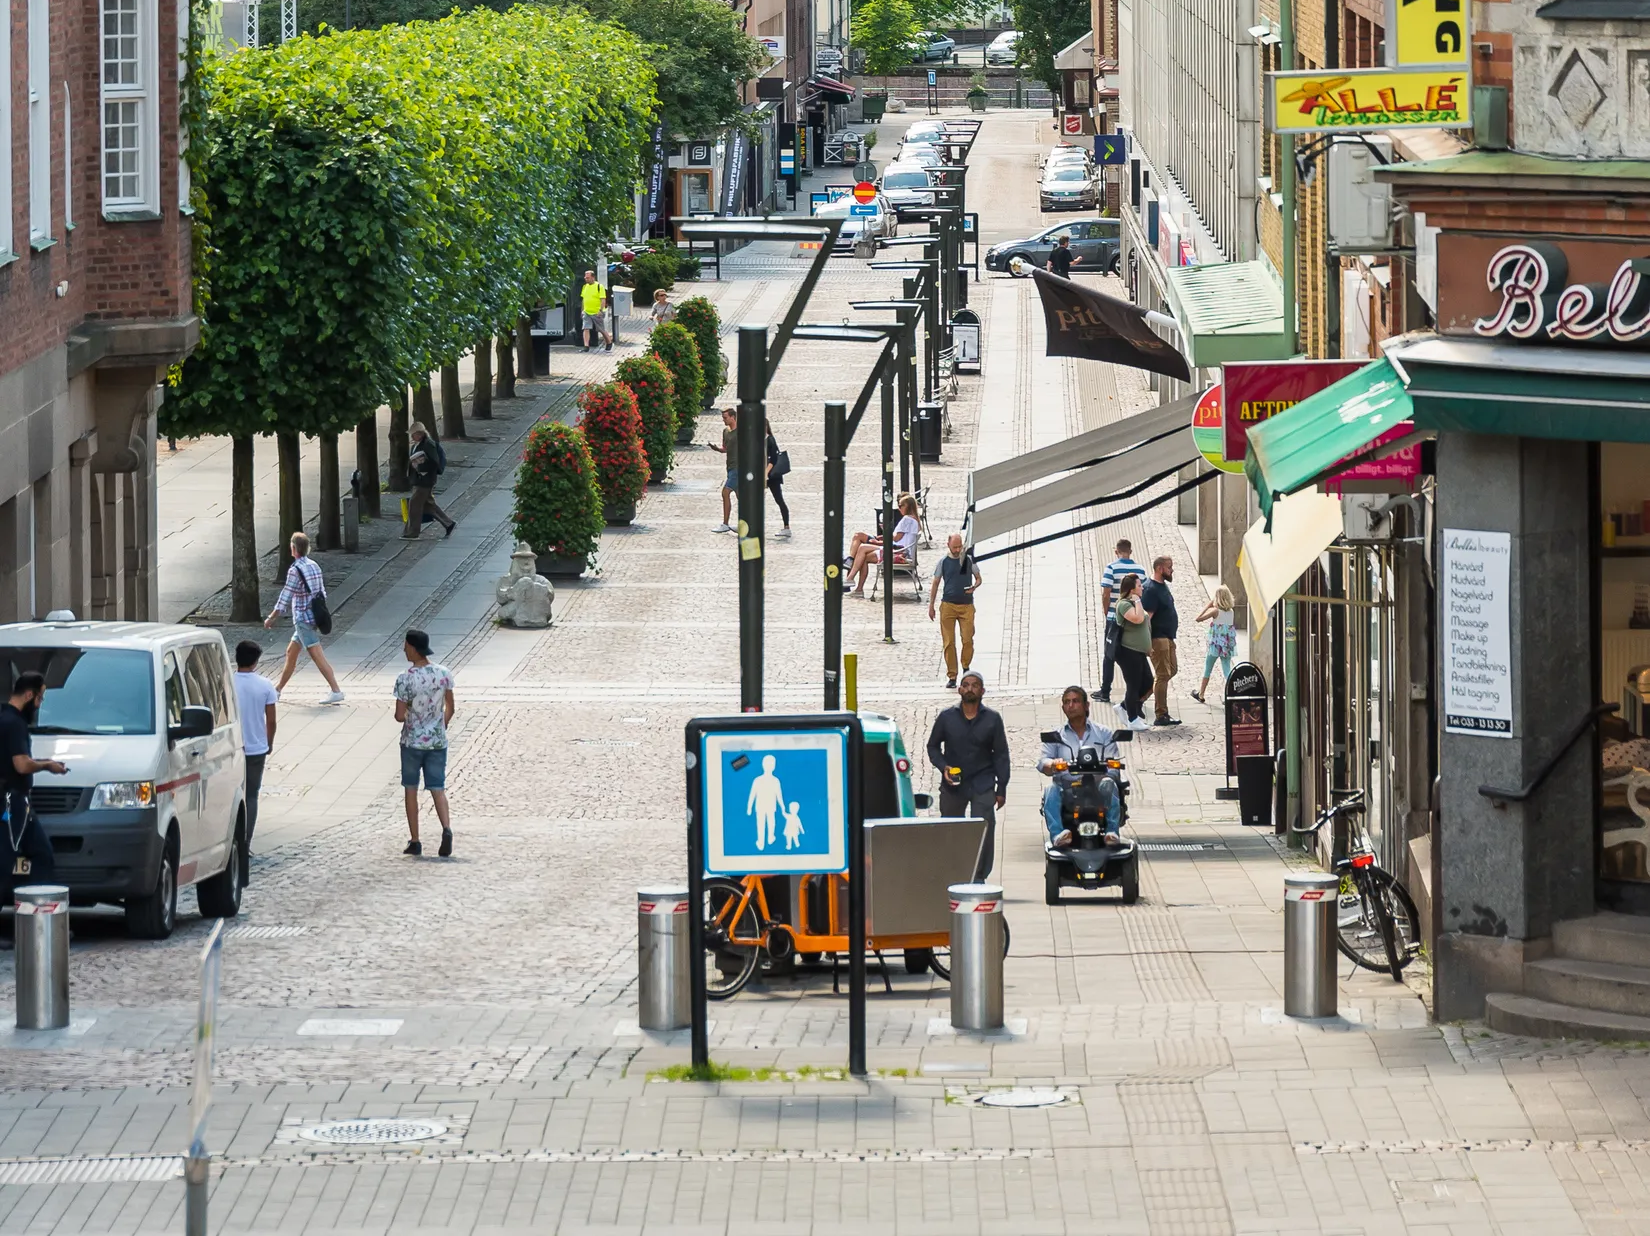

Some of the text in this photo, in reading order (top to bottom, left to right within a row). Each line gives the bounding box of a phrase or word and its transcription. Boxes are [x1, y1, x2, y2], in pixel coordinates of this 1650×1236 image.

[1299, 78, 1464, 114] ALLÉ
[728, 126, 742, 207] FRILUFTSFABRIK
[1451, 615, 1489, 632] Massage
[1451, 629, 1488, 646] Make up
[1468, 688, 1500, 704] tagning
